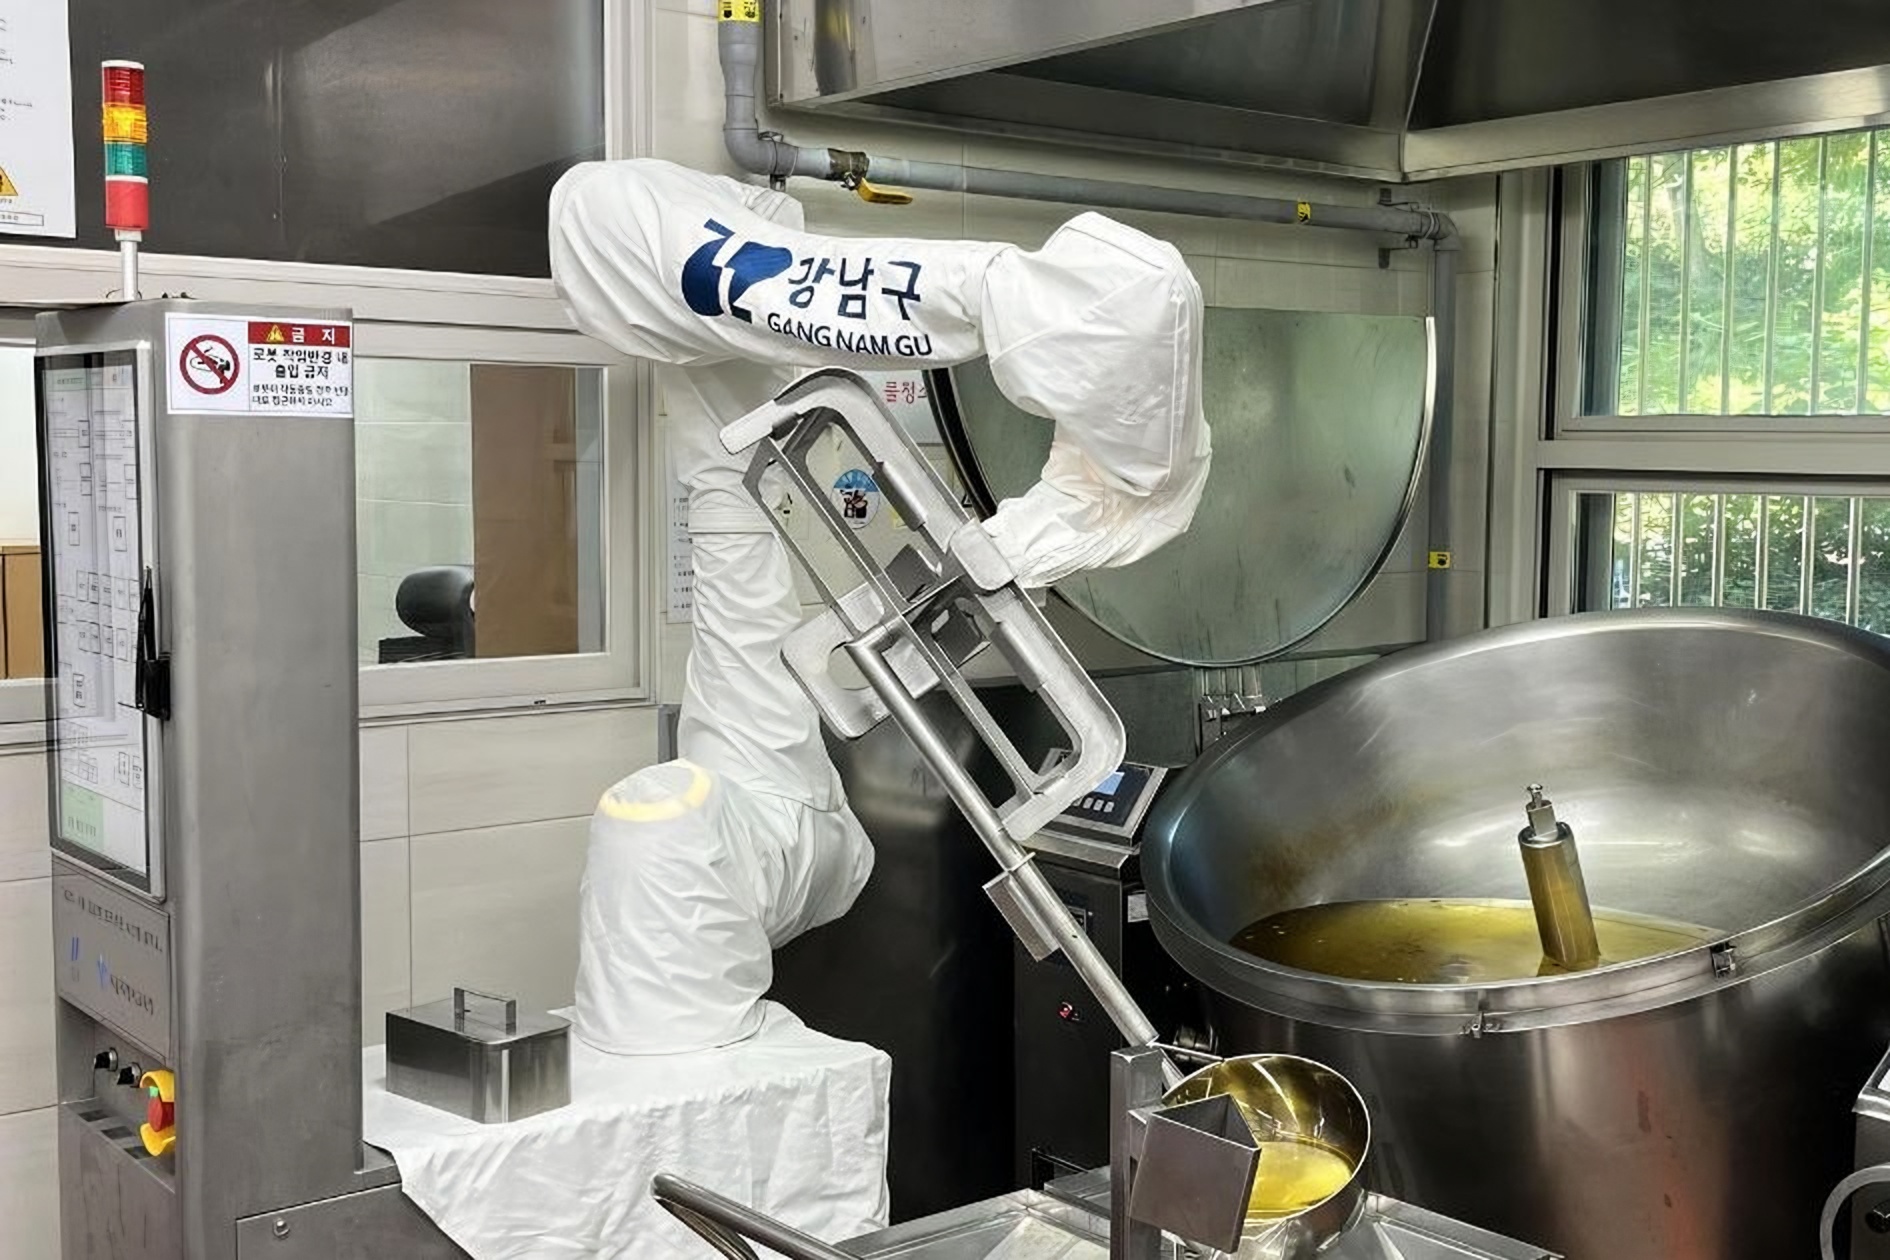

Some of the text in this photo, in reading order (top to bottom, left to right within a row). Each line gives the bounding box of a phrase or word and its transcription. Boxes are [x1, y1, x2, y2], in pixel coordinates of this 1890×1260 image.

[788, 257, 922, 321] 강남구
[895, 333, 932, 356] GU
[253, 347, 278, 363] 로봇
[304, 365, 329, 379] 금지
